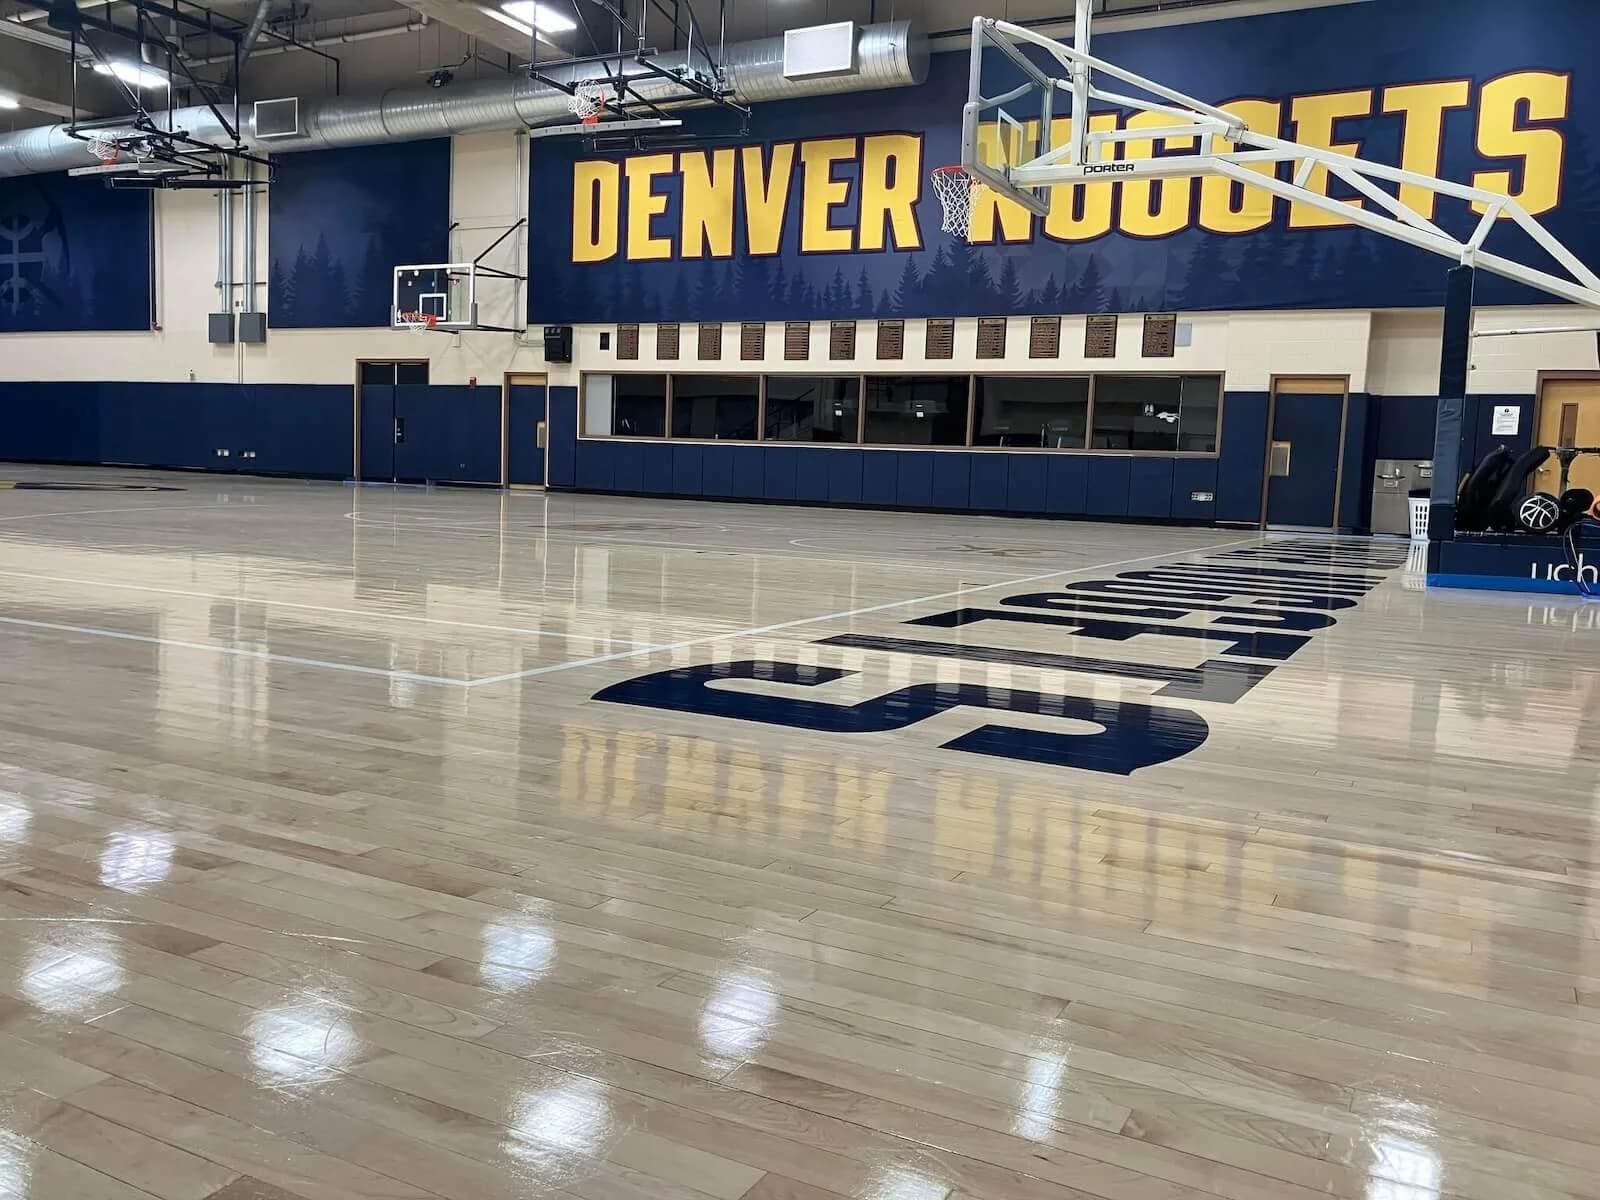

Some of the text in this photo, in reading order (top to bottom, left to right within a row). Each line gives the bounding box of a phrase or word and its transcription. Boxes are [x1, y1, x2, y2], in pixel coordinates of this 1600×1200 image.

[571, 70, 1570, 263] DENVER NUGGETS
[592, 562, 1388, 775] NUGGETS
